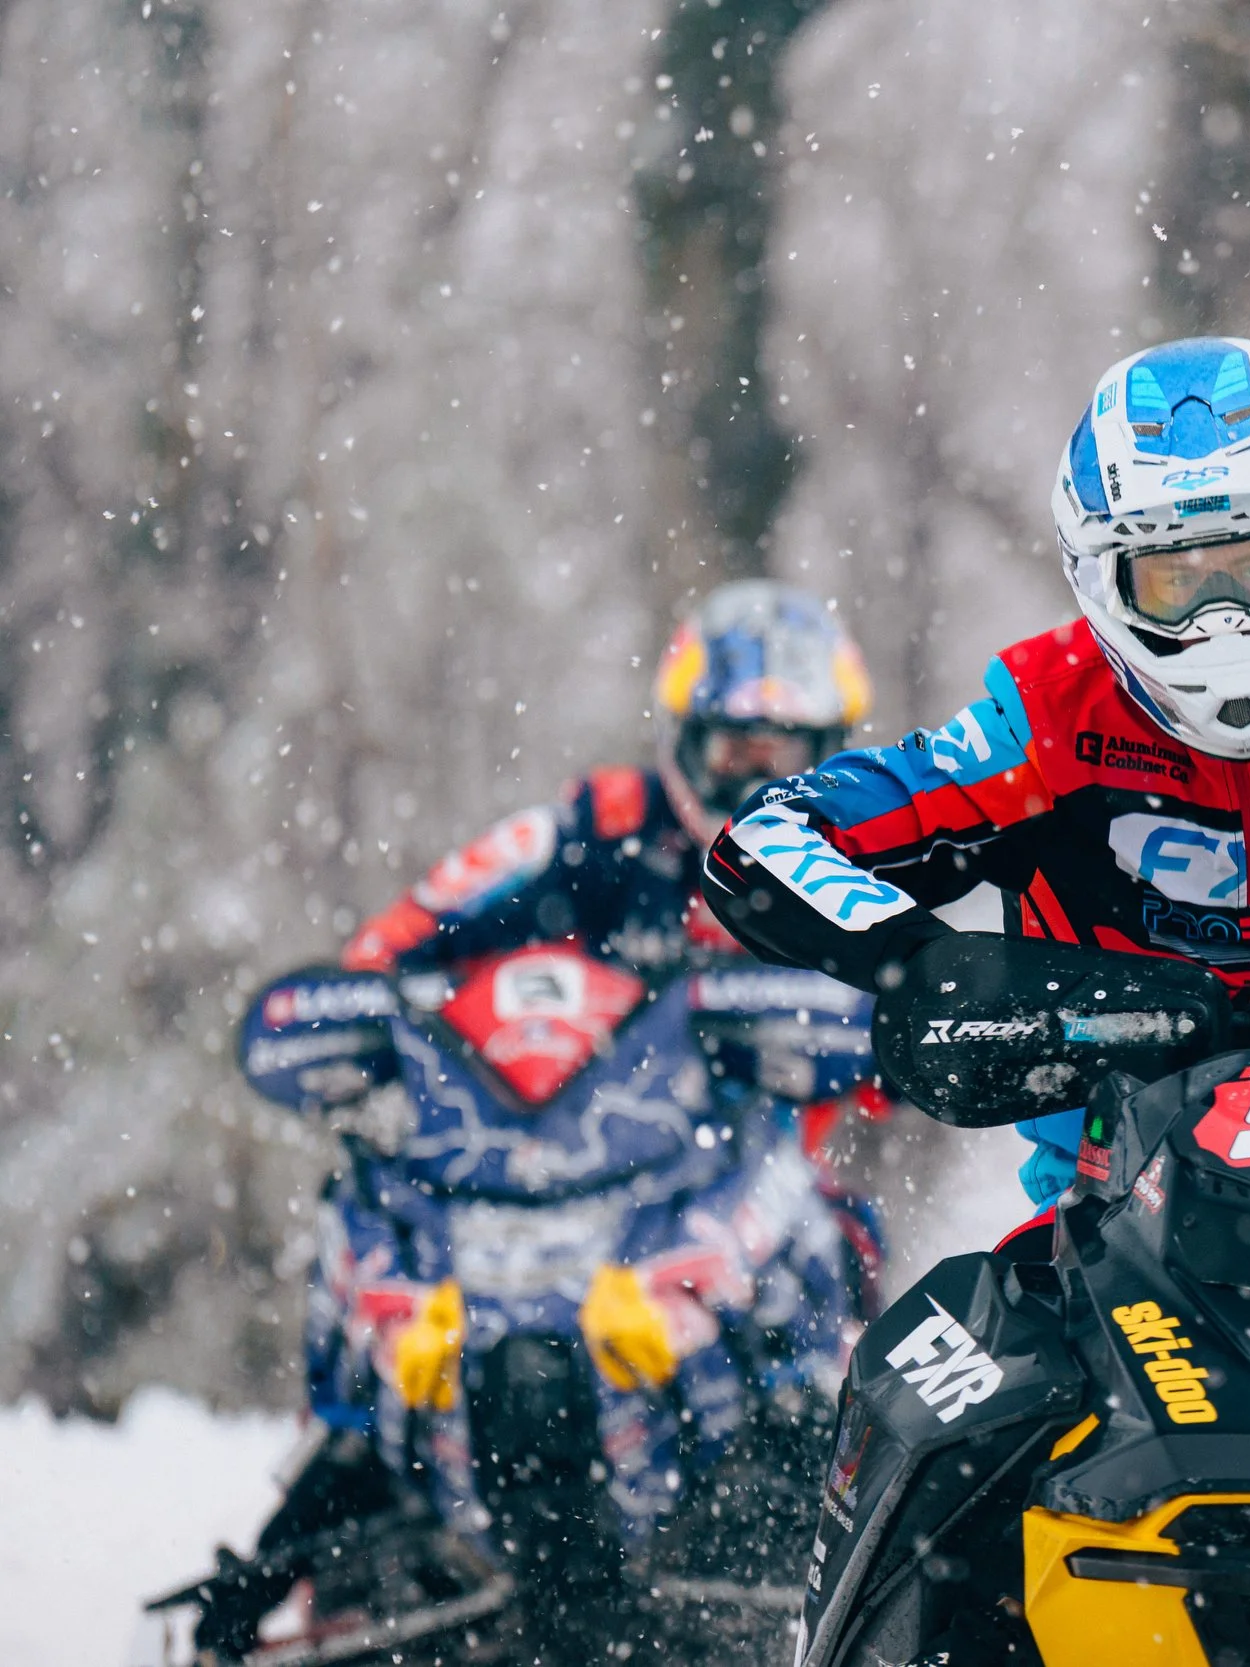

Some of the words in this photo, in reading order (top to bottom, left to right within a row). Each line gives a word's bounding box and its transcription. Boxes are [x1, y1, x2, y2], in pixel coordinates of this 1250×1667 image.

[1104, 753, 1167, 776] Cabinet
[884, 1291, 1004, 1424] FXR
[1111, 1300, 1218, 1424] ski-doo
